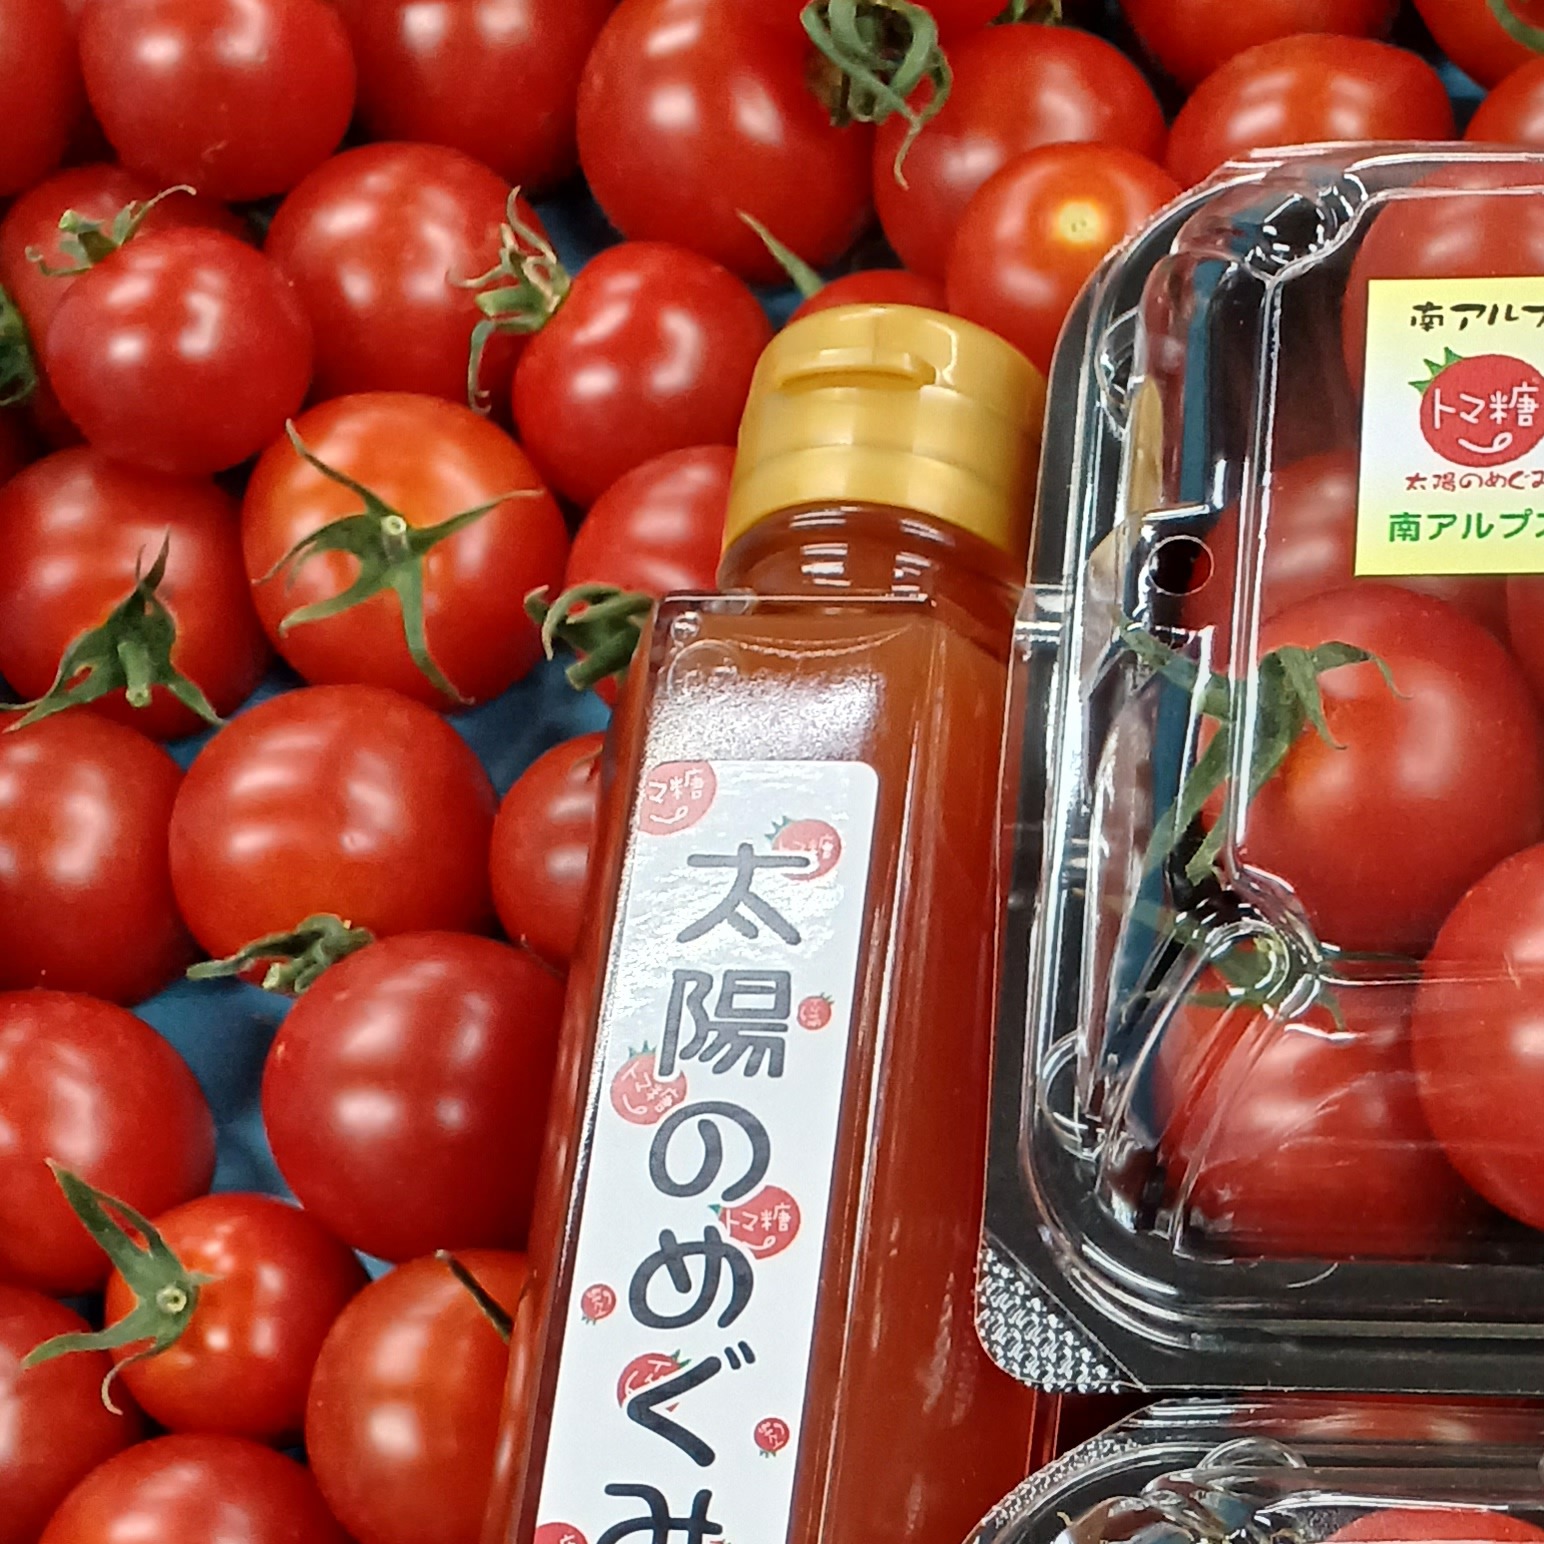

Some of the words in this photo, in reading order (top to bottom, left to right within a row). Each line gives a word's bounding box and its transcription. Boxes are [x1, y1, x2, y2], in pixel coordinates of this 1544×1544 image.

[1434, 381, 1539, 429] トマ糖
[649, 769, 704, 800] マ糖
[724, 1205, 791, 1232] トマ糖
